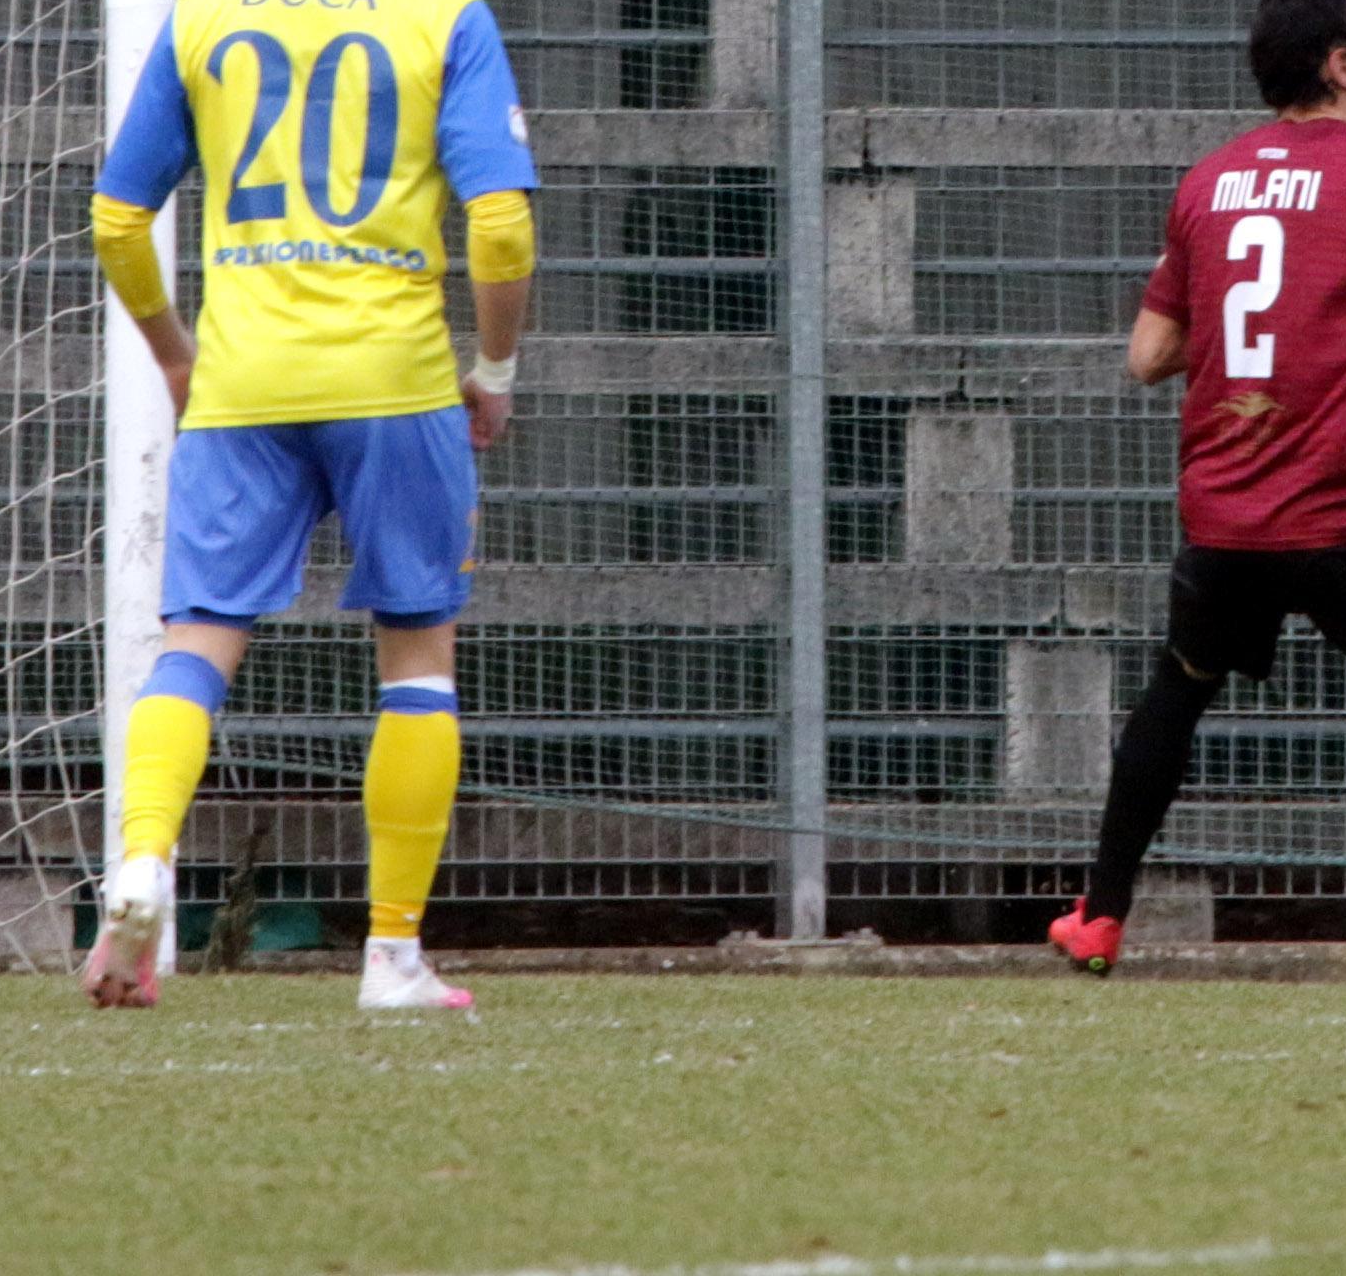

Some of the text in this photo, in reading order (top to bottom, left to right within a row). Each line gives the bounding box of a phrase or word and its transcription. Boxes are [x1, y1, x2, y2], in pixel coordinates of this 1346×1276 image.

[205, 29, 400, 228] 20
[1210, 169, 1323, 212] MILANI
[1223, 214, 1285, 379] 2
